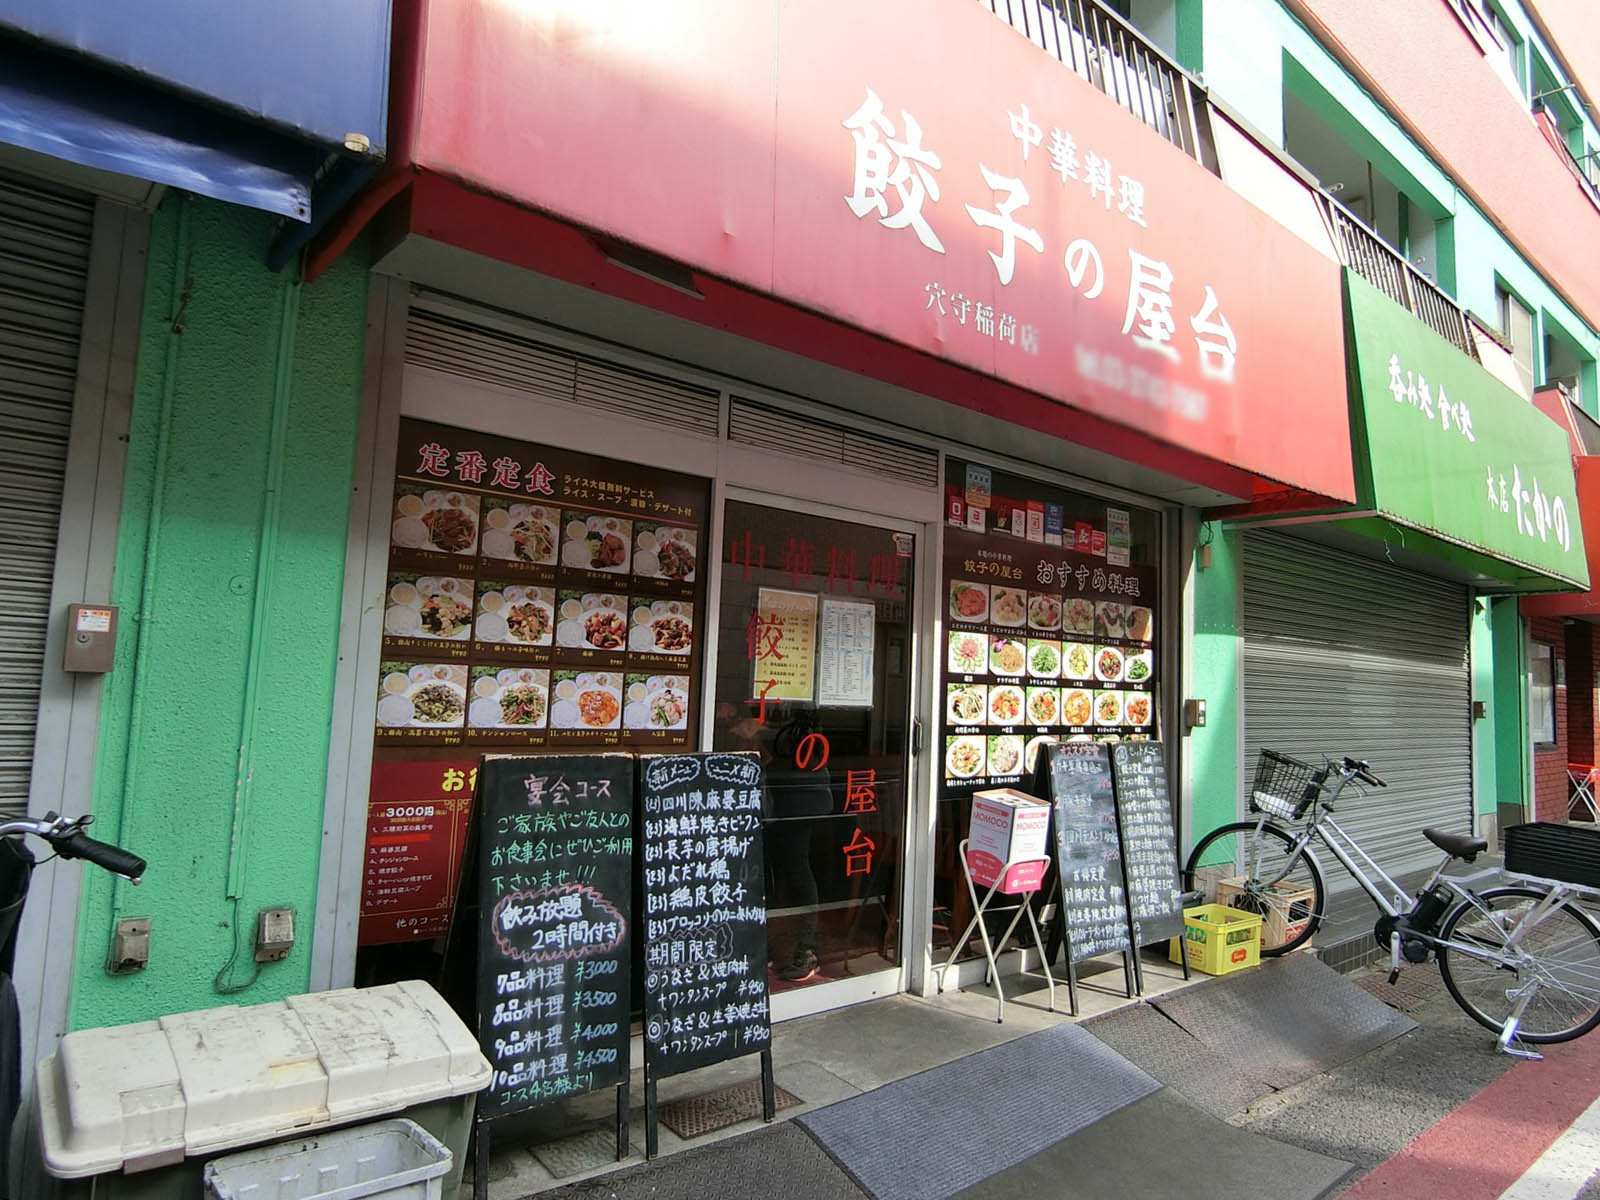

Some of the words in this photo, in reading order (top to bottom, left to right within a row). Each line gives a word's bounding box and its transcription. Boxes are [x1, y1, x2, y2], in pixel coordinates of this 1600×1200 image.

[1007, 104, 1147, 228] 中華料理
[841, 86, 1237, 383] 餃子の屋台
[416, 443, 555, 496] 定番定食
[1511, 463, 1569, 552] たかの
[964, 559, 1025, 580] 餃子の屋台
[1037, 560, 1141, 597] おすすめ料理
[441, 768, 478, 792] お
[524, 773, 611, 805] 宴会コース
[386, 806, 435, 818] 3000円
[662, 786, 762, 812] 四川陳麻婆豆腐
[497, 810, 630, 834] ご家族やご友人との
[663, 813, 761, 837] 海鮮焼きビーフン
[491, 836, 632, 867] お食事会にぜひご利用
[664, 834, 754, 860] 長芋の唐揚げ
[499, 893, 583, 930] 飲み放題
[669, 881, 748, 911] 鶏皮餃子
[396, 914, 449, 928] 他のコース
[530, 920, 618, 950] 2時間付き
[649, 937, 718, 966] 期間限定
[497, 963, 565, 995] 7品料理
[492, 993, 565, 1026] 8品料理
[495, 1024, 564, 1059] 9品料理
[490, 1053, 569, 1092] 10品料理
